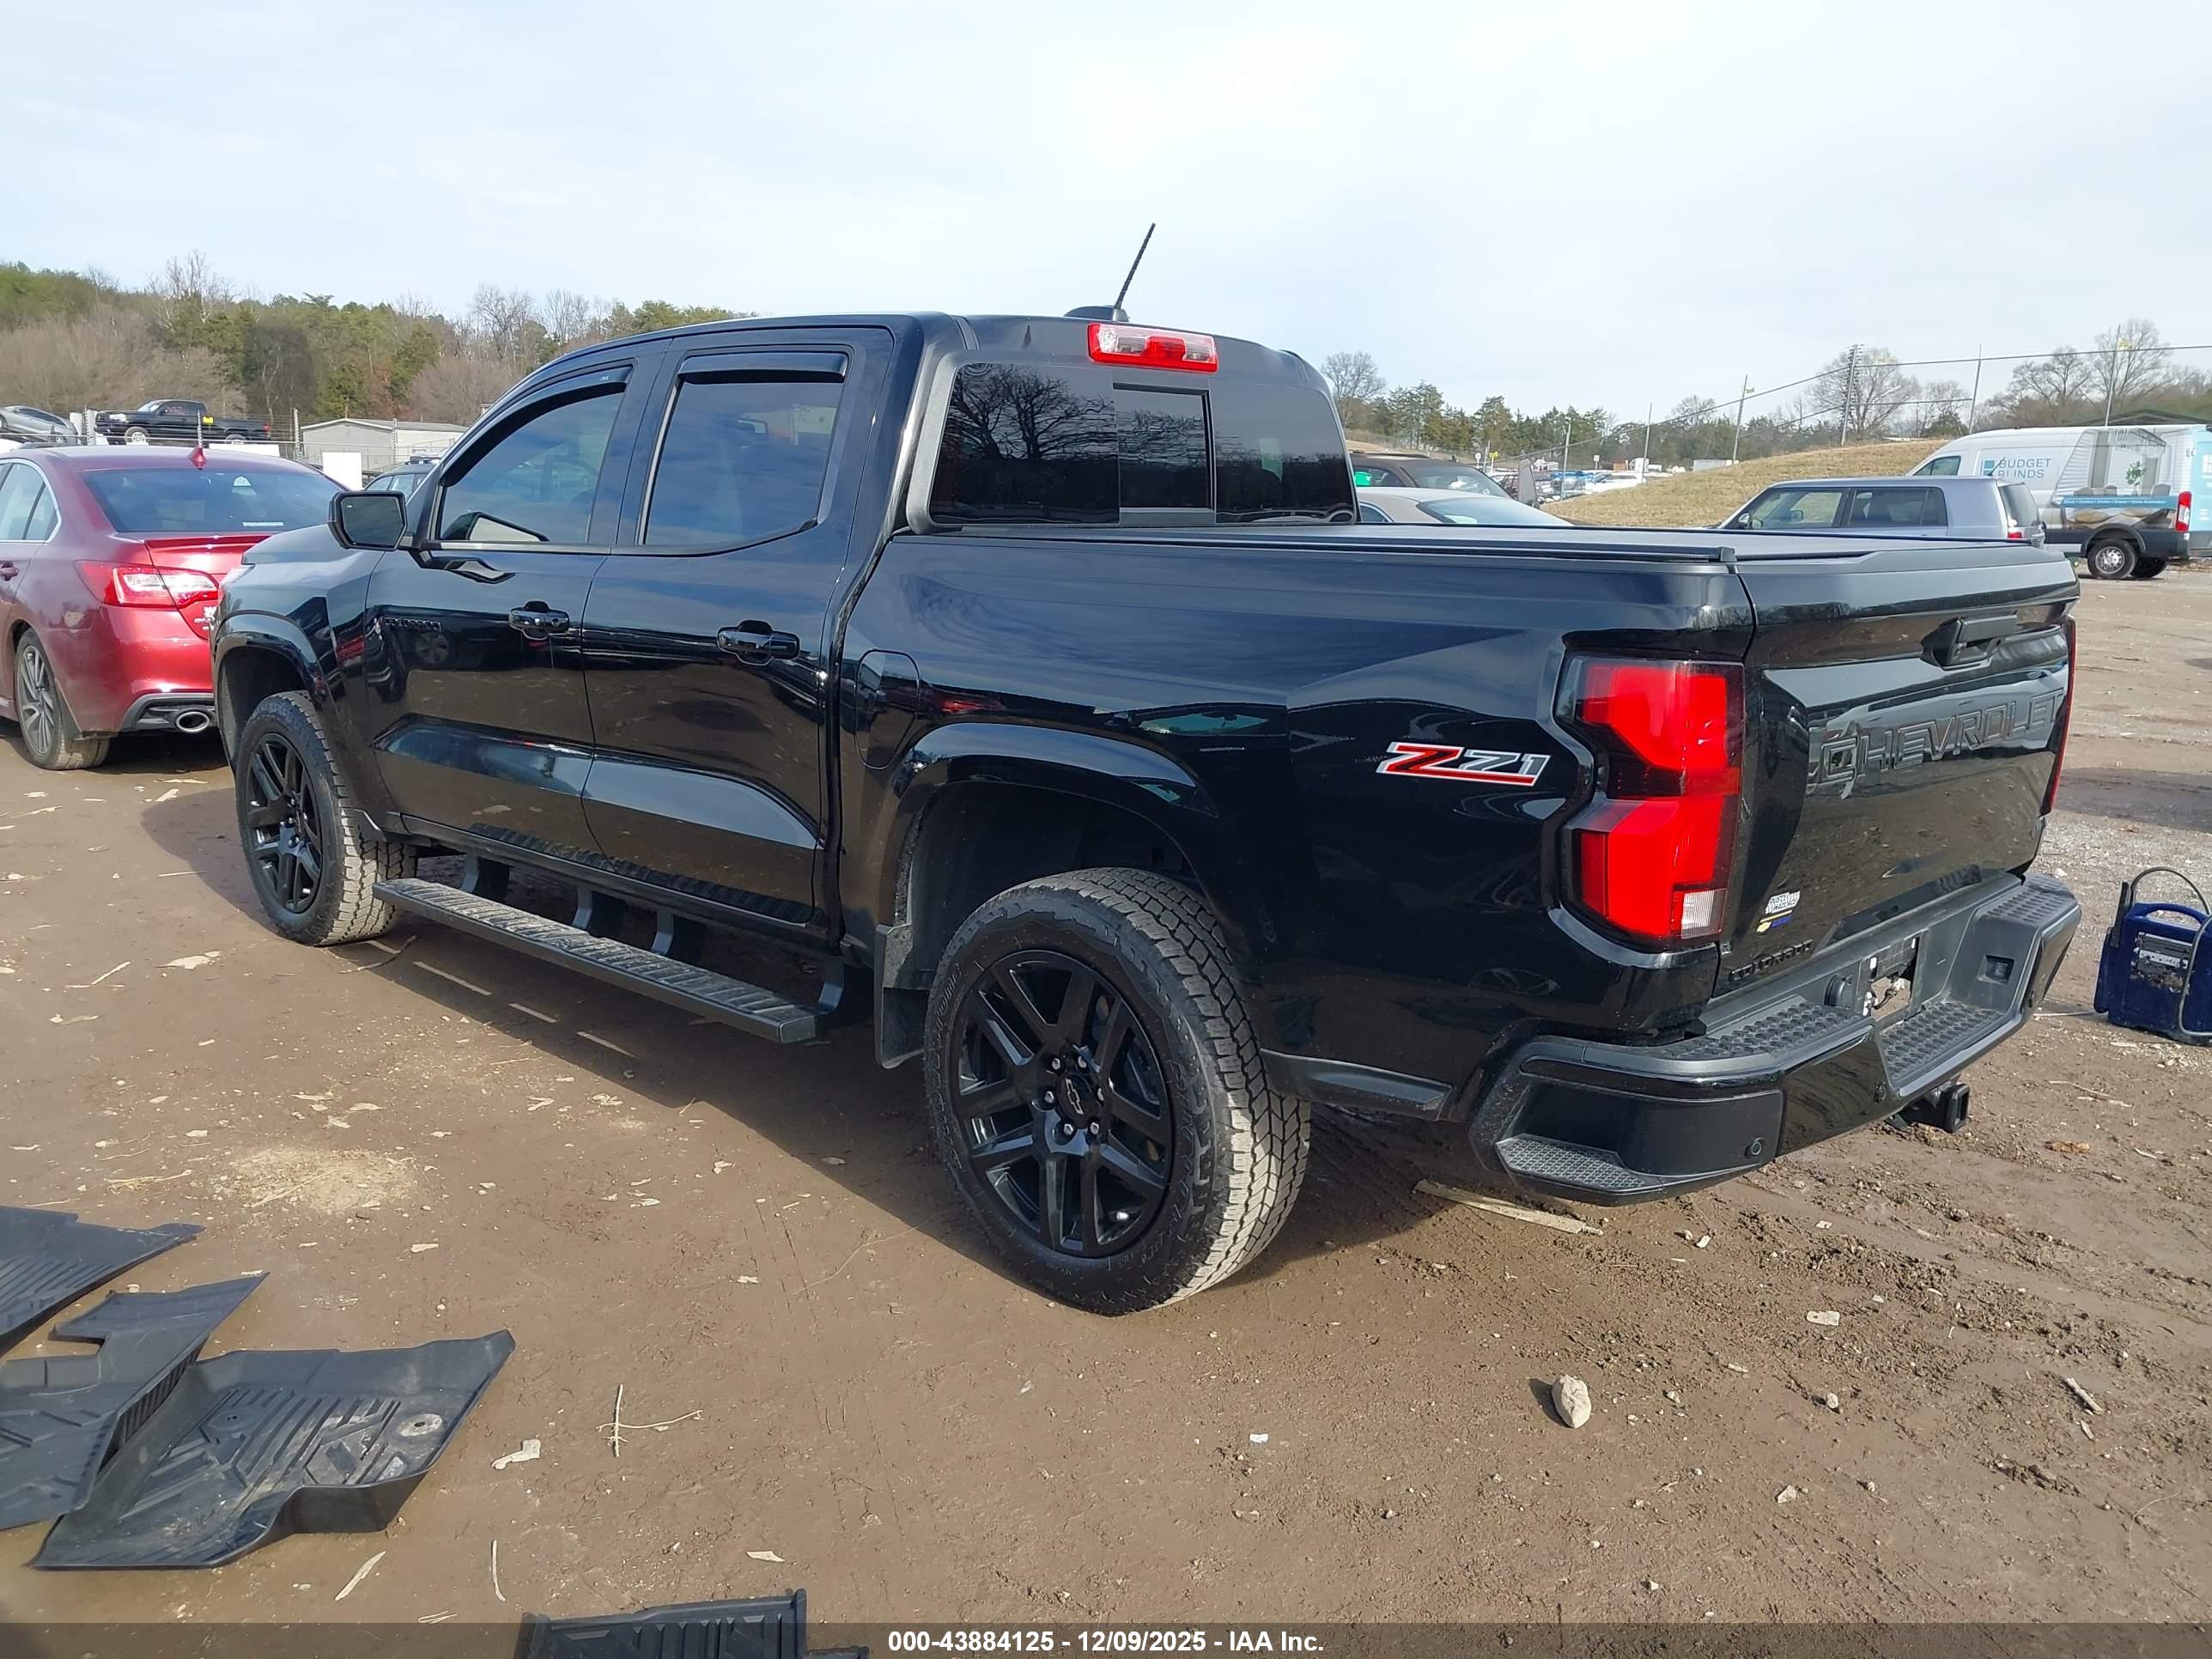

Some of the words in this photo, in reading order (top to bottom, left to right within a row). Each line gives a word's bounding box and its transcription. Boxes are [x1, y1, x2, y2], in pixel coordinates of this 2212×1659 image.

[1999, 459, 2051, 468] BUDGET
[1818, 687, 2066, 784] CHEVROLET
[1376, 741, 1552, 787] Z71
